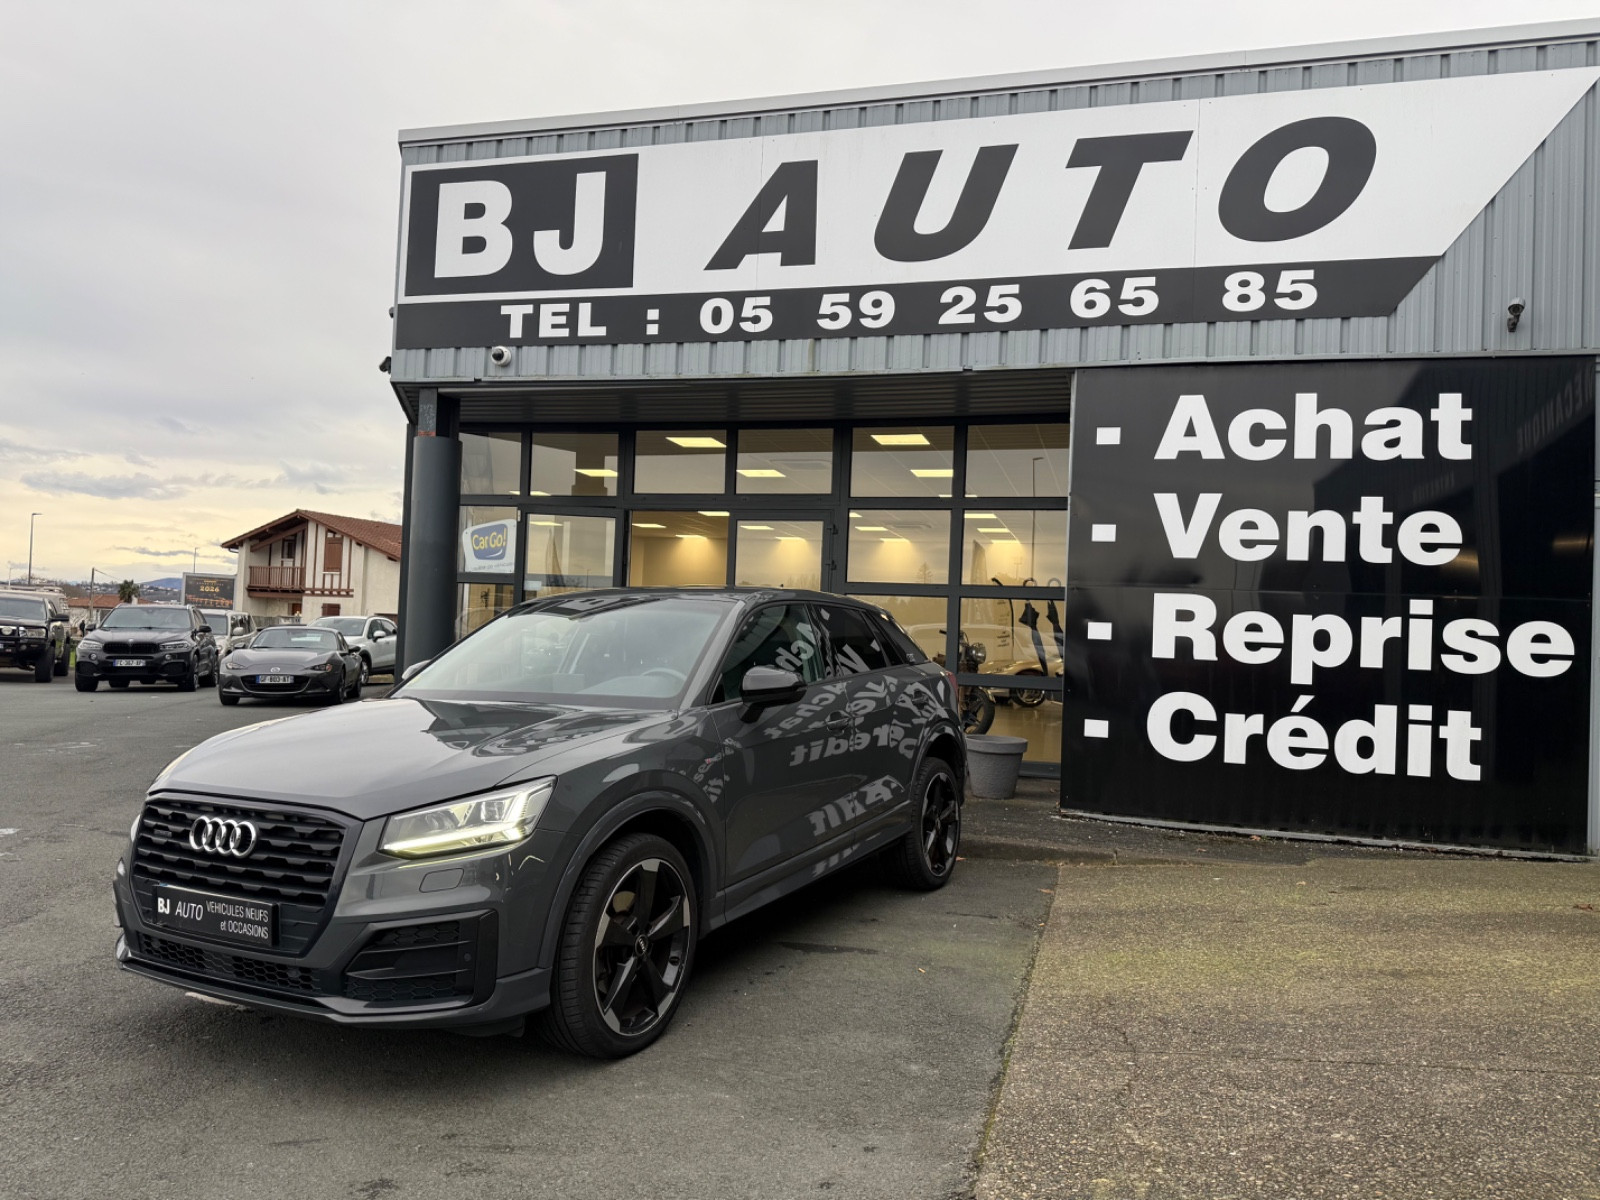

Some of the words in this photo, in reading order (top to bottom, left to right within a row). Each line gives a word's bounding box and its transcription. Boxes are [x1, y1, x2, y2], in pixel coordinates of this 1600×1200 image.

[433, 171, 607, 278] BJ
[703, 116, 1377, 271] AUTO
[500, 303, 606, 338] TEL
[699, 297, 774, 333] 05
[816, 290, 895, 329] 59
[938, 285, 1022, 325] 25
[1069, 277, 1159, 318] 65
[1221, 269, 1318, 312] 85
[1154, 392, 1473, 461] Achat
[1153, 493, 1463, 566] Vente
[1152, 593, 1576, 685] Reprise
[1146, 691, 1482, 781] Crédit
[158, 897, 170, 914] BJ
[175, 901, 203, 920] AUTO
[206, 900, 243, 918] VEHICULES
[246, 907, 268, 922] NEUFS
[220, 921, 227, 931] et
[228, 920, 268, 938] OCCASIONS
